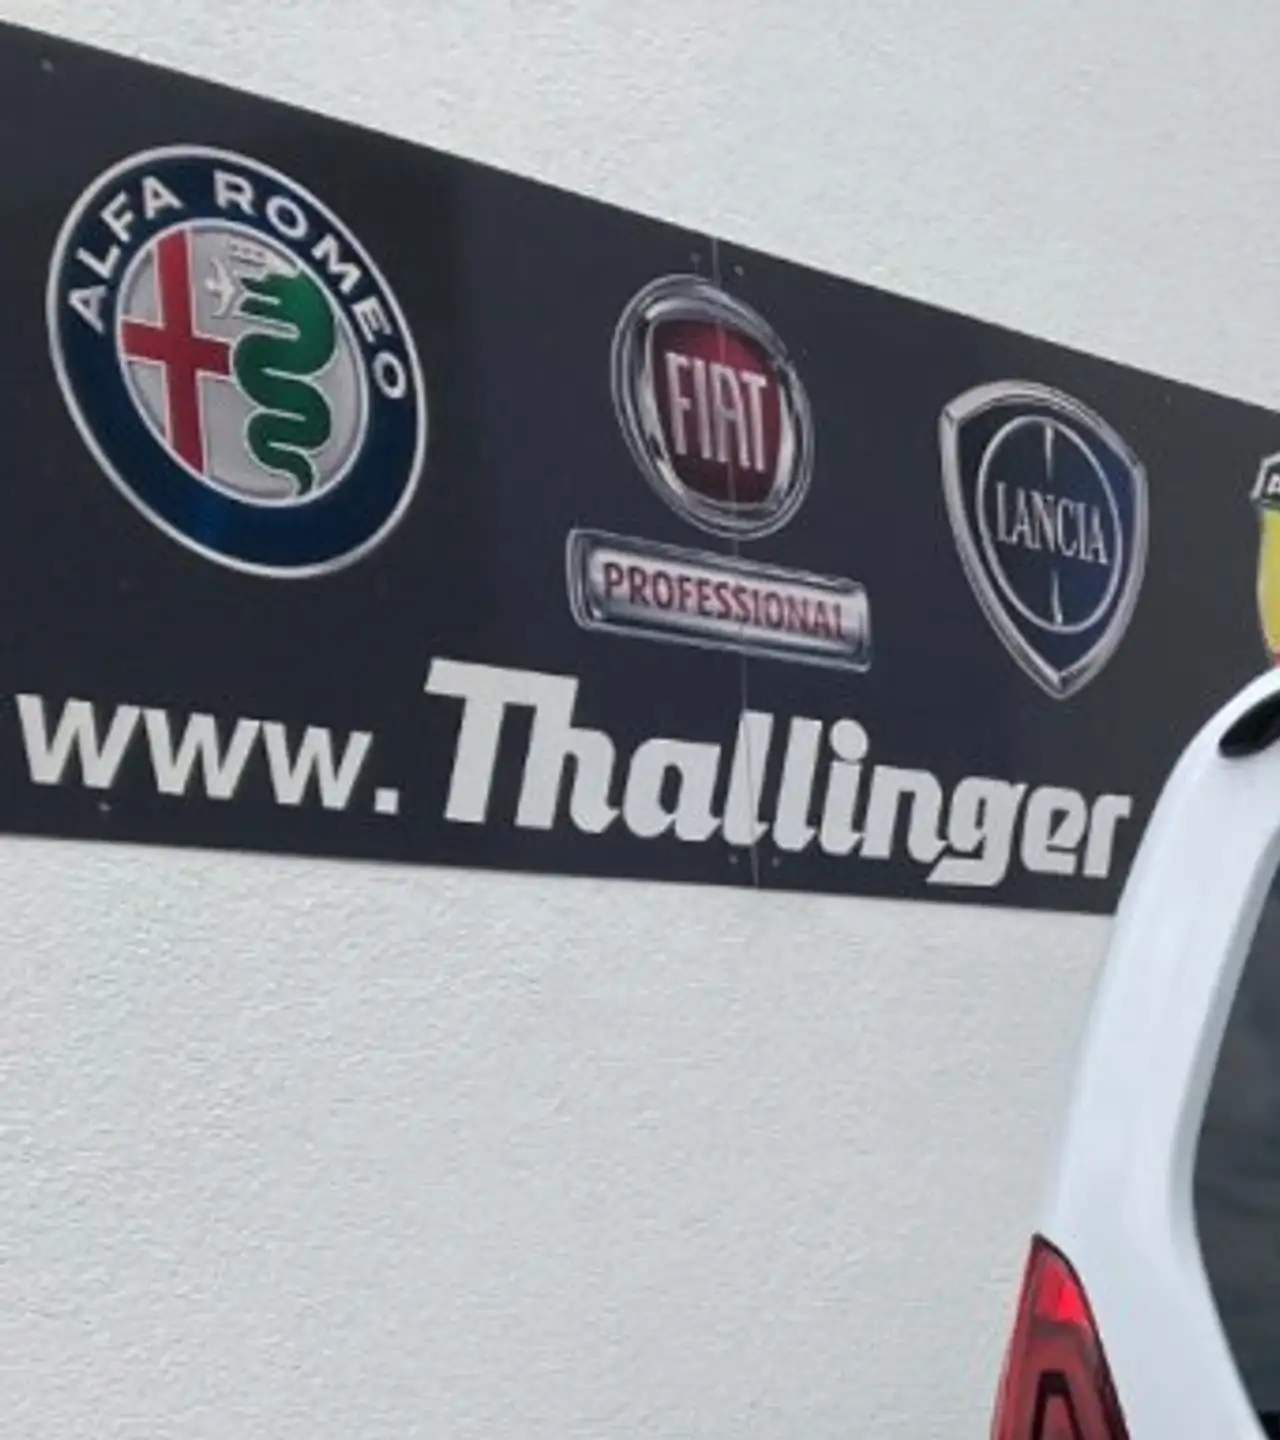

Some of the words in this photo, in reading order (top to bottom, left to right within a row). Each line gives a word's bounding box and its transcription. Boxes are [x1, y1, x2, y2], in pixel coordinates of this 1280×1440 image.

[68, 173, 184, 333] ALFA
[213, 169, 409, 401] ROMEO
[663, 350, 769, 475] FIAT
[995, 481, 1109, 566] LANCIA
[602, 560, 848, 641] PROFESSIONAL
